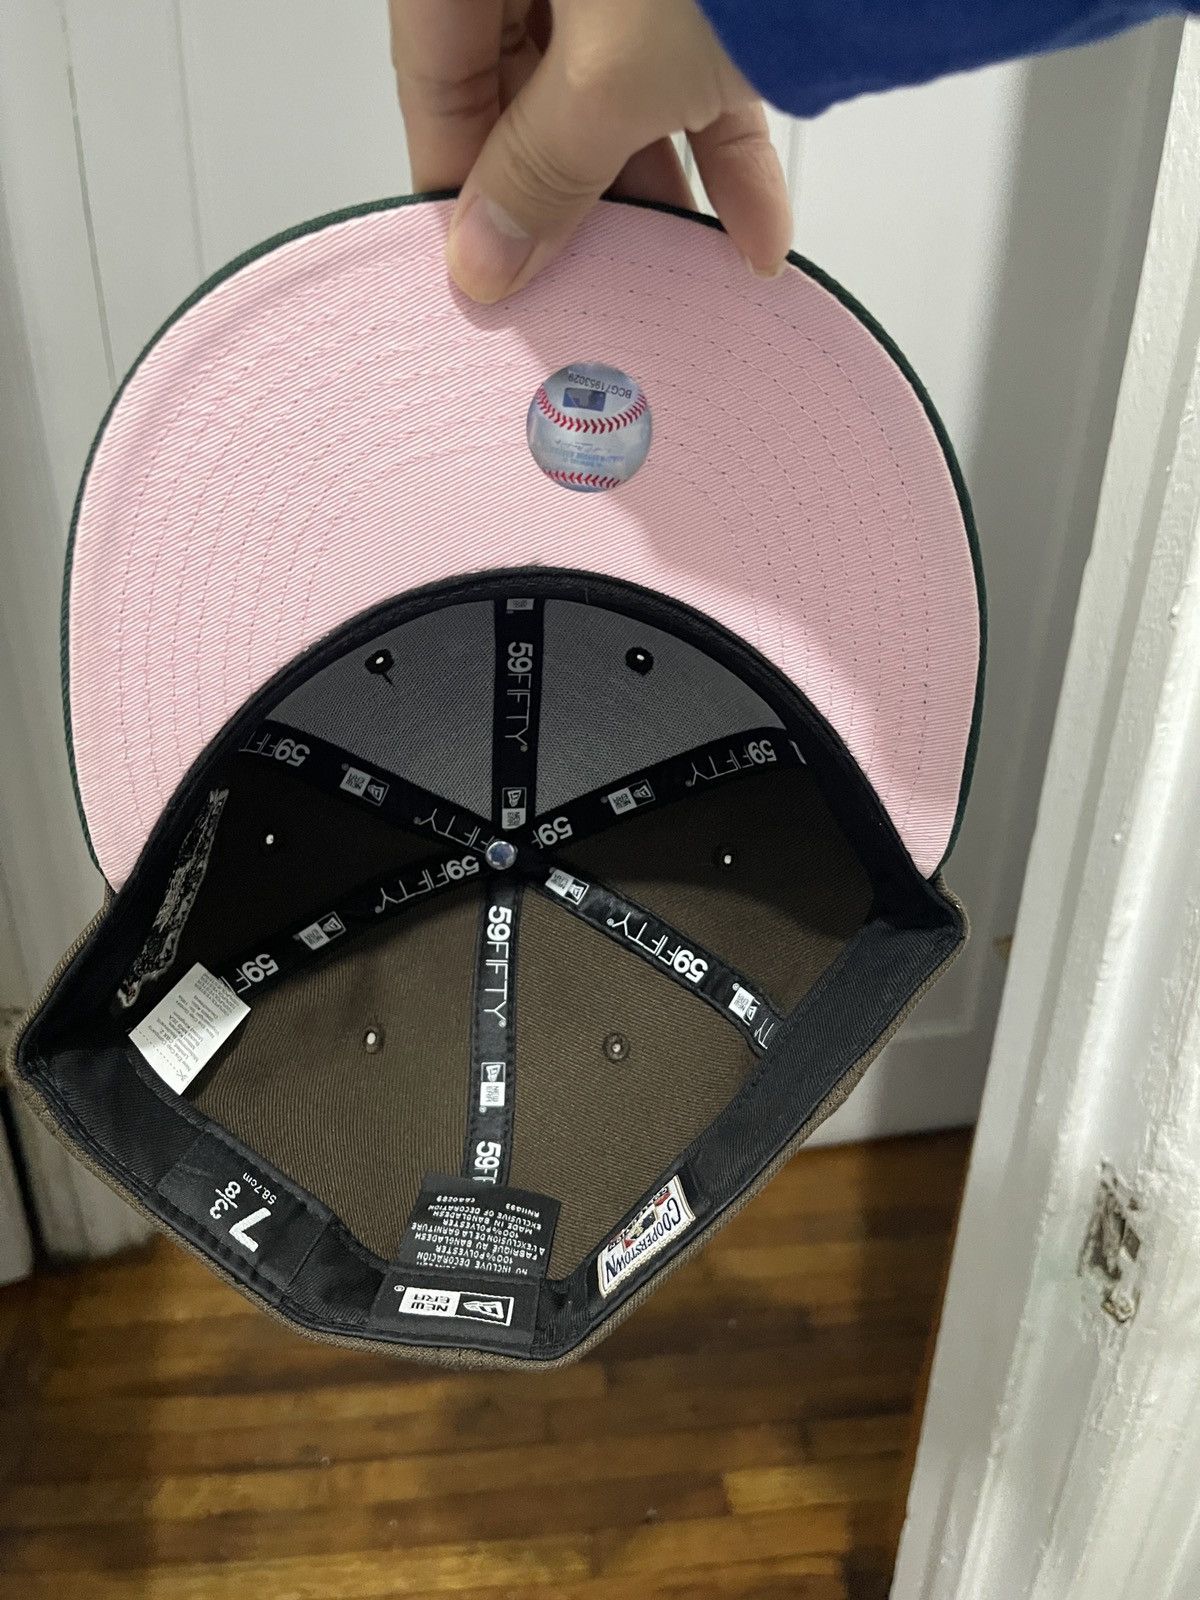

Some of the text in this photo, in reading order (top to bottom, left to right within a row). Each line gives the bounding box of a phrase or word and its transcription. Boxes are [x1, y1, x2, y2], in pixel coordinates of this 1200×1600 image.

[505, 641, 533, 745] 59FIFTY
[692, 739, 777, 785] 59FIFTY
[380, 854, 481, 911] 59FIFTY
[612, 912, 708, 983] 59FIFTY
[483, 904, 511, 1020] 59FIFTY
[428, 1204, 480, 1214] DECORATION
[433, 1211, 490, 1224] BANGLADESH
[497, 1212, 542, 1230] EXCLUSIVE
[228, 1207, 271, 1253] 7
[411, 1222, 460, 1236] GARNITURE
[462, 1230, 473, 1239] LA
[475, 1232, 485, 1240] DE
[507, 1223, 532, 1235] MADE
[415, 1232, 472, 1248] BANGLADESH
[605, 1197, 682, 1284] COOPERSTOWN
[475, 1259, 512, 1274] INCLUYE
[413, 1292, 450, 1304] ERA
[410, 1300, 448, 1312] NEW
